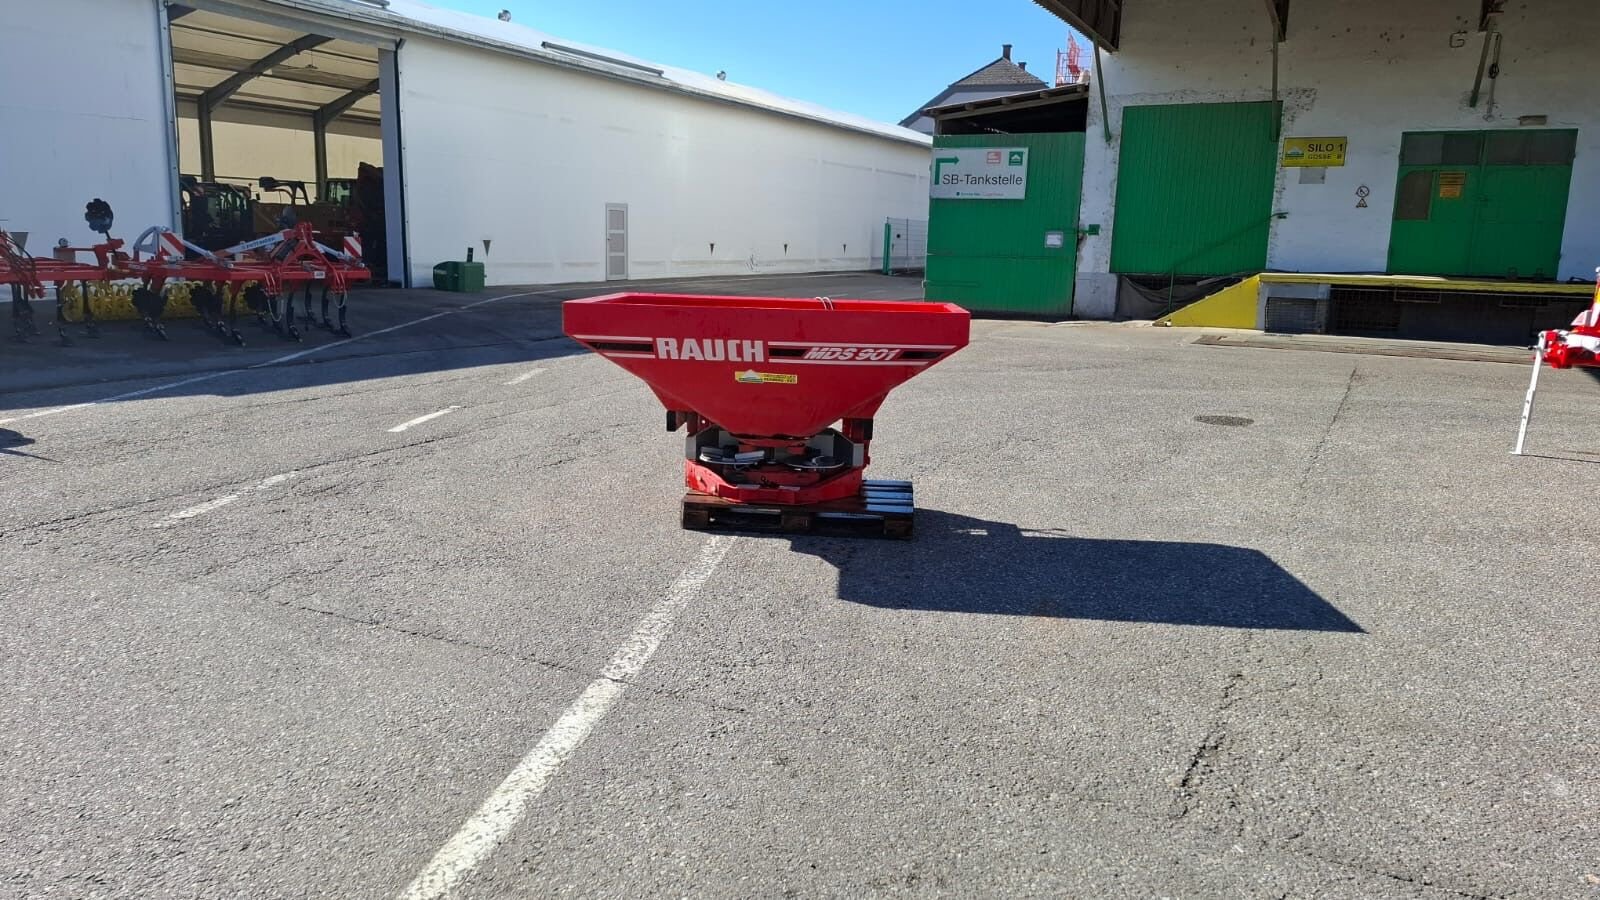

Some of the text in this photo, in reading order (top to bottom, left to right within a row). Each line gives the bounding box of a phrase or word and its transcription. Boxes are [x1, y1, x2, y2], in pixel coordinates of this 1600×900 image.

[1307, 143, 1334, 152] SILO
[942, 174, 1023, 185] SB-Tankstelle
[656, 337, 765, 362] RAUCH
[804, 347, 901, 360] MDS 901
